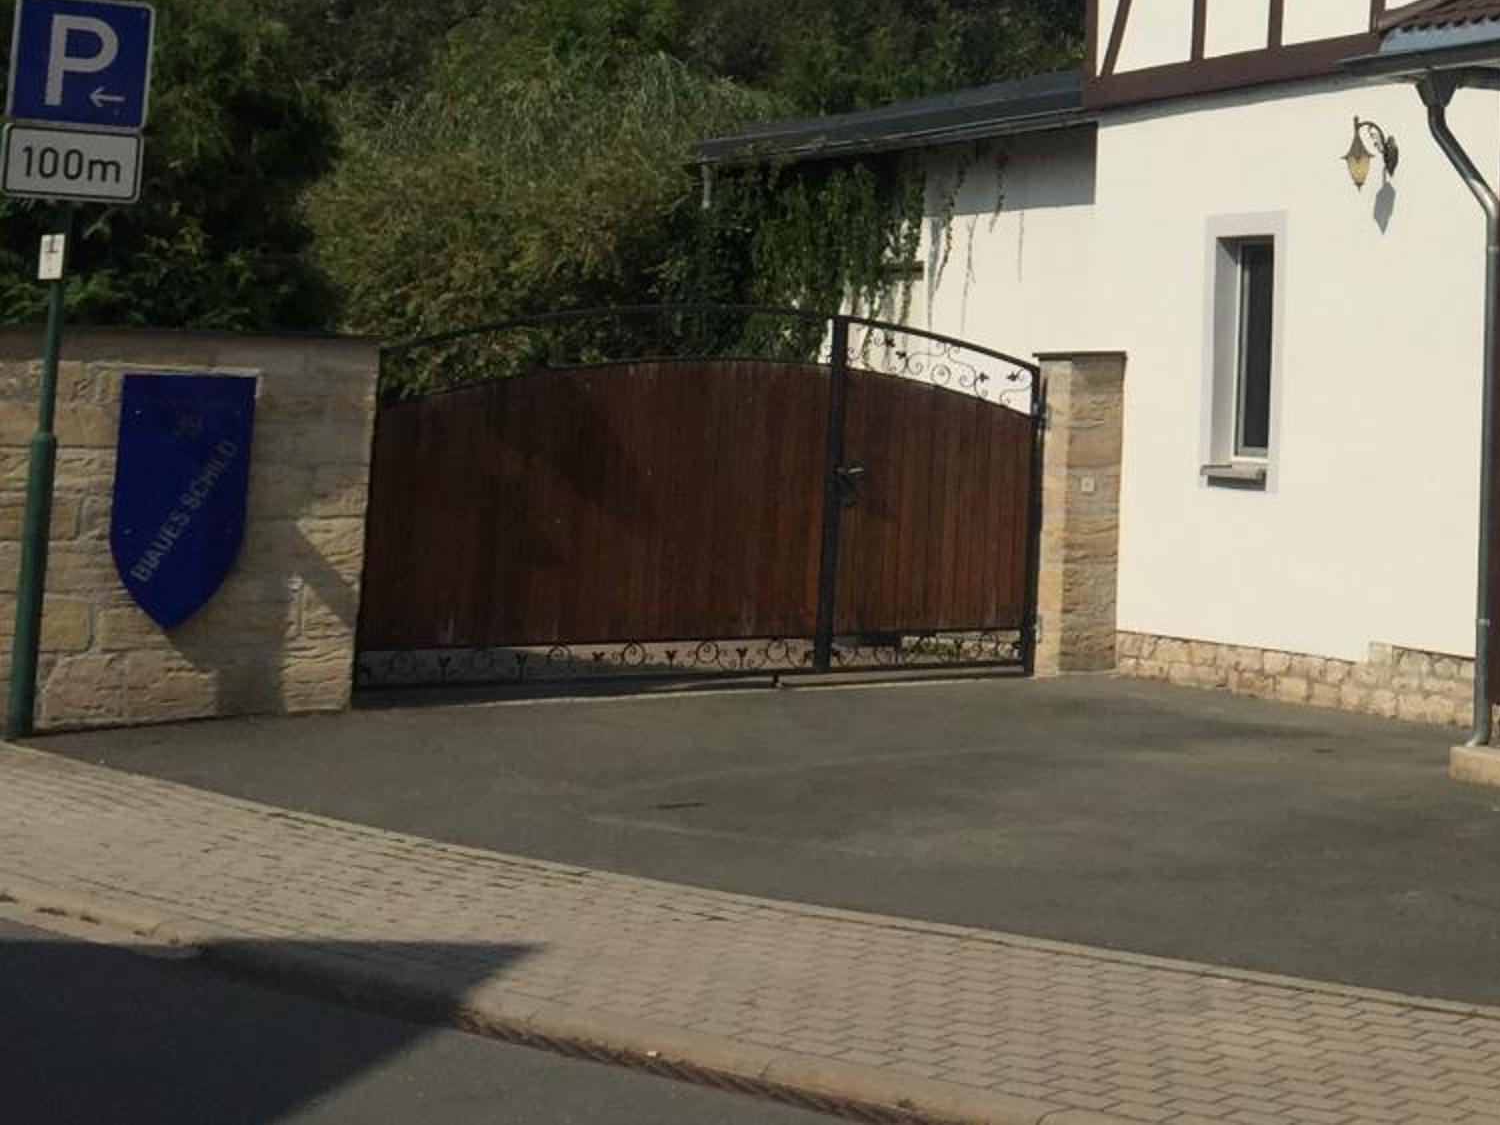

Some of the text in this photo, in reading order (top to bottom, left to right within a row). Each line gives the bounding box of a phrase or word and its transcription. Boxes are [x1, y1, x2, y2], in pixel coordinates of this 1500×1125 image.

[45, 14, 119, 106] P
[21, 146, 121, 183] 100m
[131, 440, 238, 582] BLAUES SCHILD
